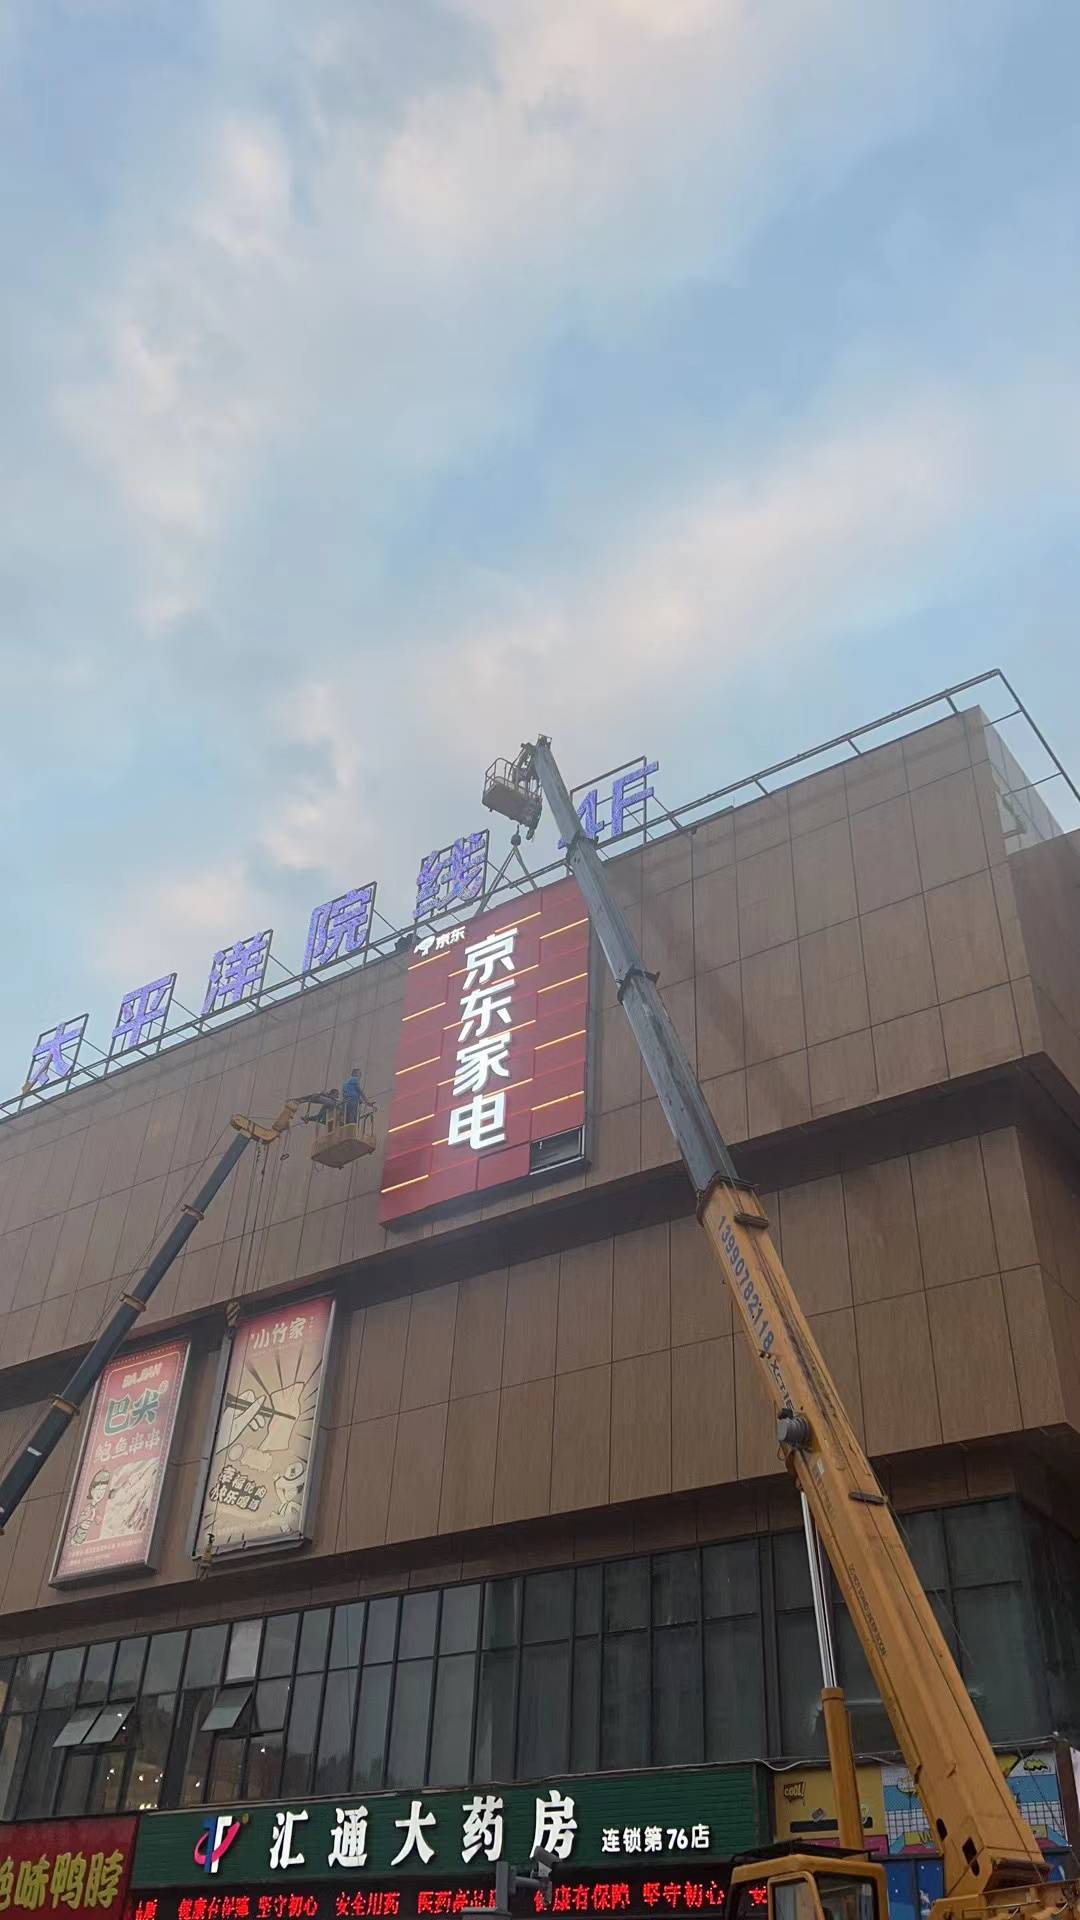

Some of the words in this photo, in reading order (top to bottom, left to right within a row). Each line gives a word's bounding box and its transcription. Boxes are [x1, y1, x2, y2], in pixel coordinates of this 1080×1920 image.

[29, 831, 486, 1089] 太平洋院线
[435, 926, 466, 950] 京东
[447, 928, 518, 1150] 京东家电
[718, 1215, 776, 1351] 13990782118
[269, 1789, 578, 1869] 汇通大药房
[601, 1823, 709, 1853] 连锁第76店
[335, 1891, 401, 1916] 安全用药
[642, 1880, 725, 1908] 坚守初心
